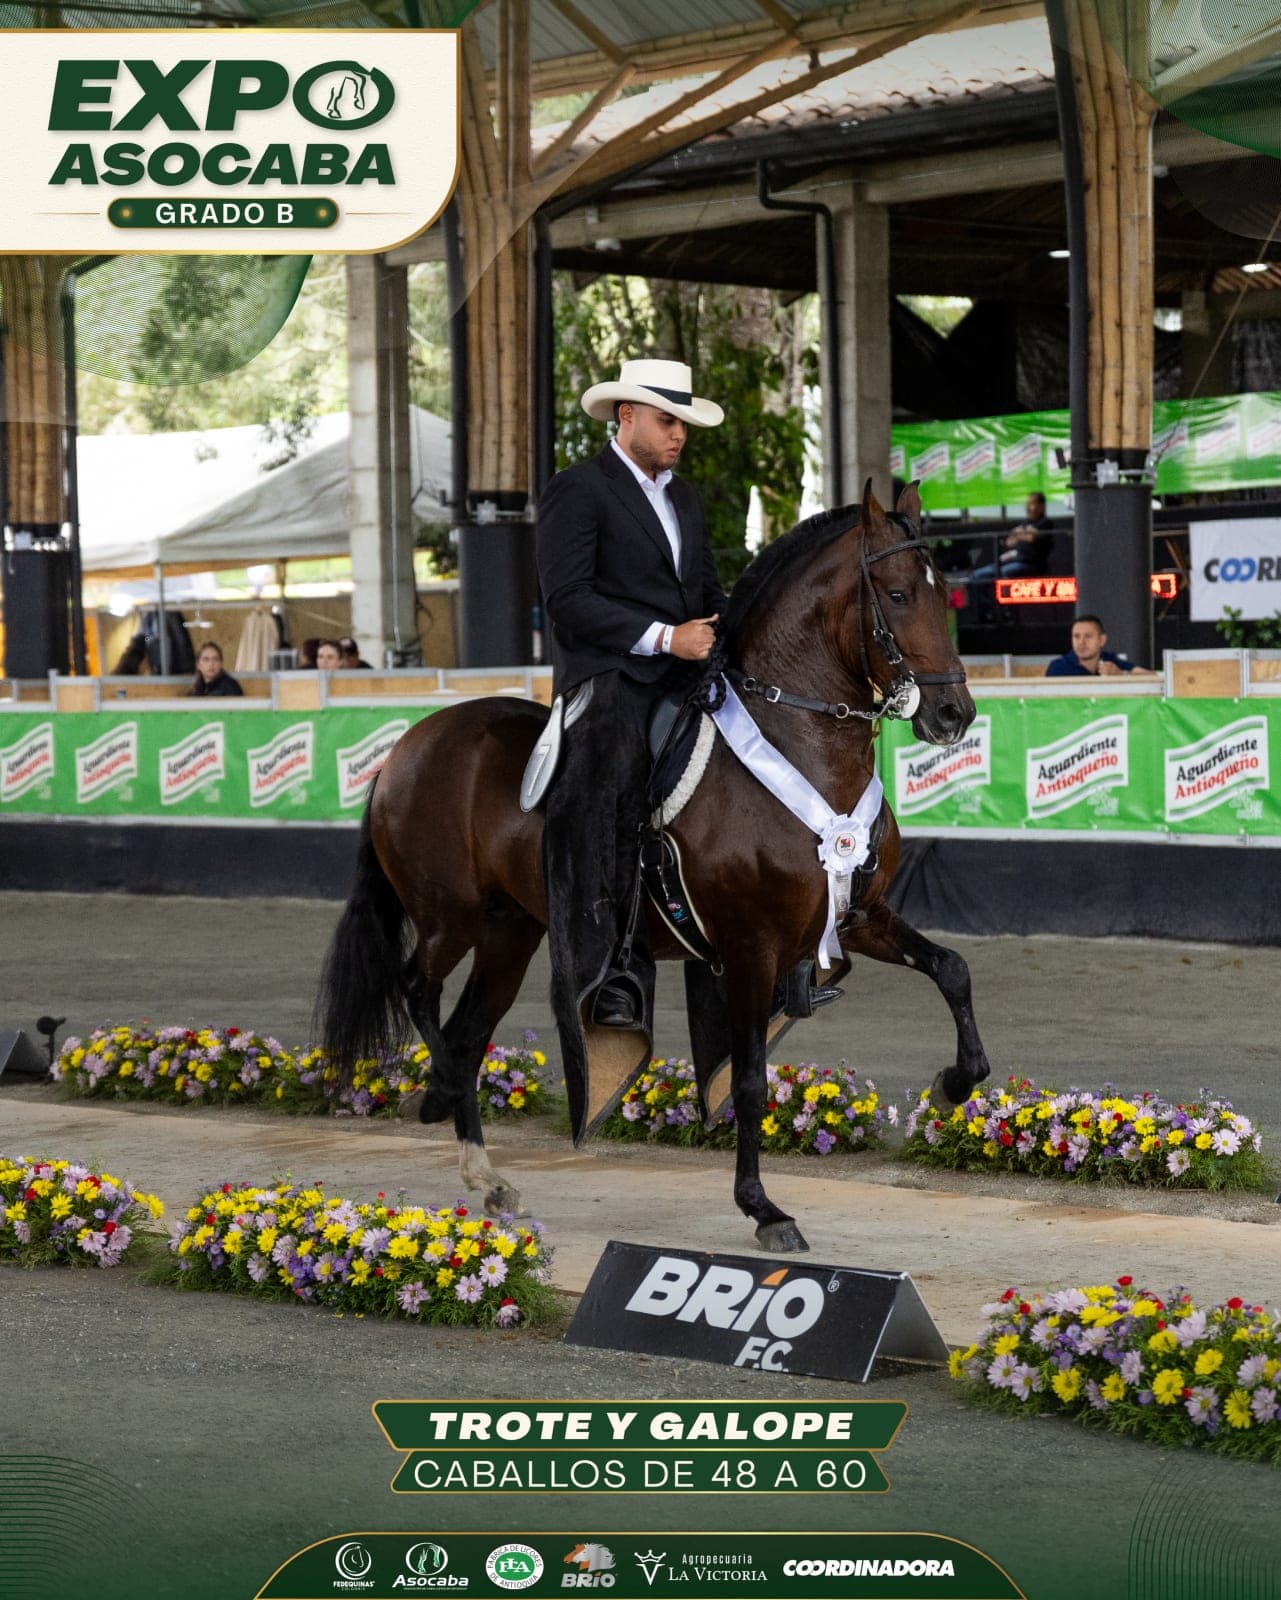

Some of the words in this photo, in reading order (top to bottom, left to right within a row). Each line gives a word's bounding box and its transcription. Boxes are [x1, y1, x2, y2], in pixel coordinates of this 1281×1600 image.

[1203, 556, 1281, 584] COOR
[905, 750, 982, 796] Antioqueño
[906, 736, 981, 779] Aguardiente
[1036, 751, 1119, 798] Antioqueño
[1037, 736, 1118, 781] Aguardiente
[1174, 753, 1259, 800] Antioqueño
[1176, 738, 1258, 783] Aguardiente
